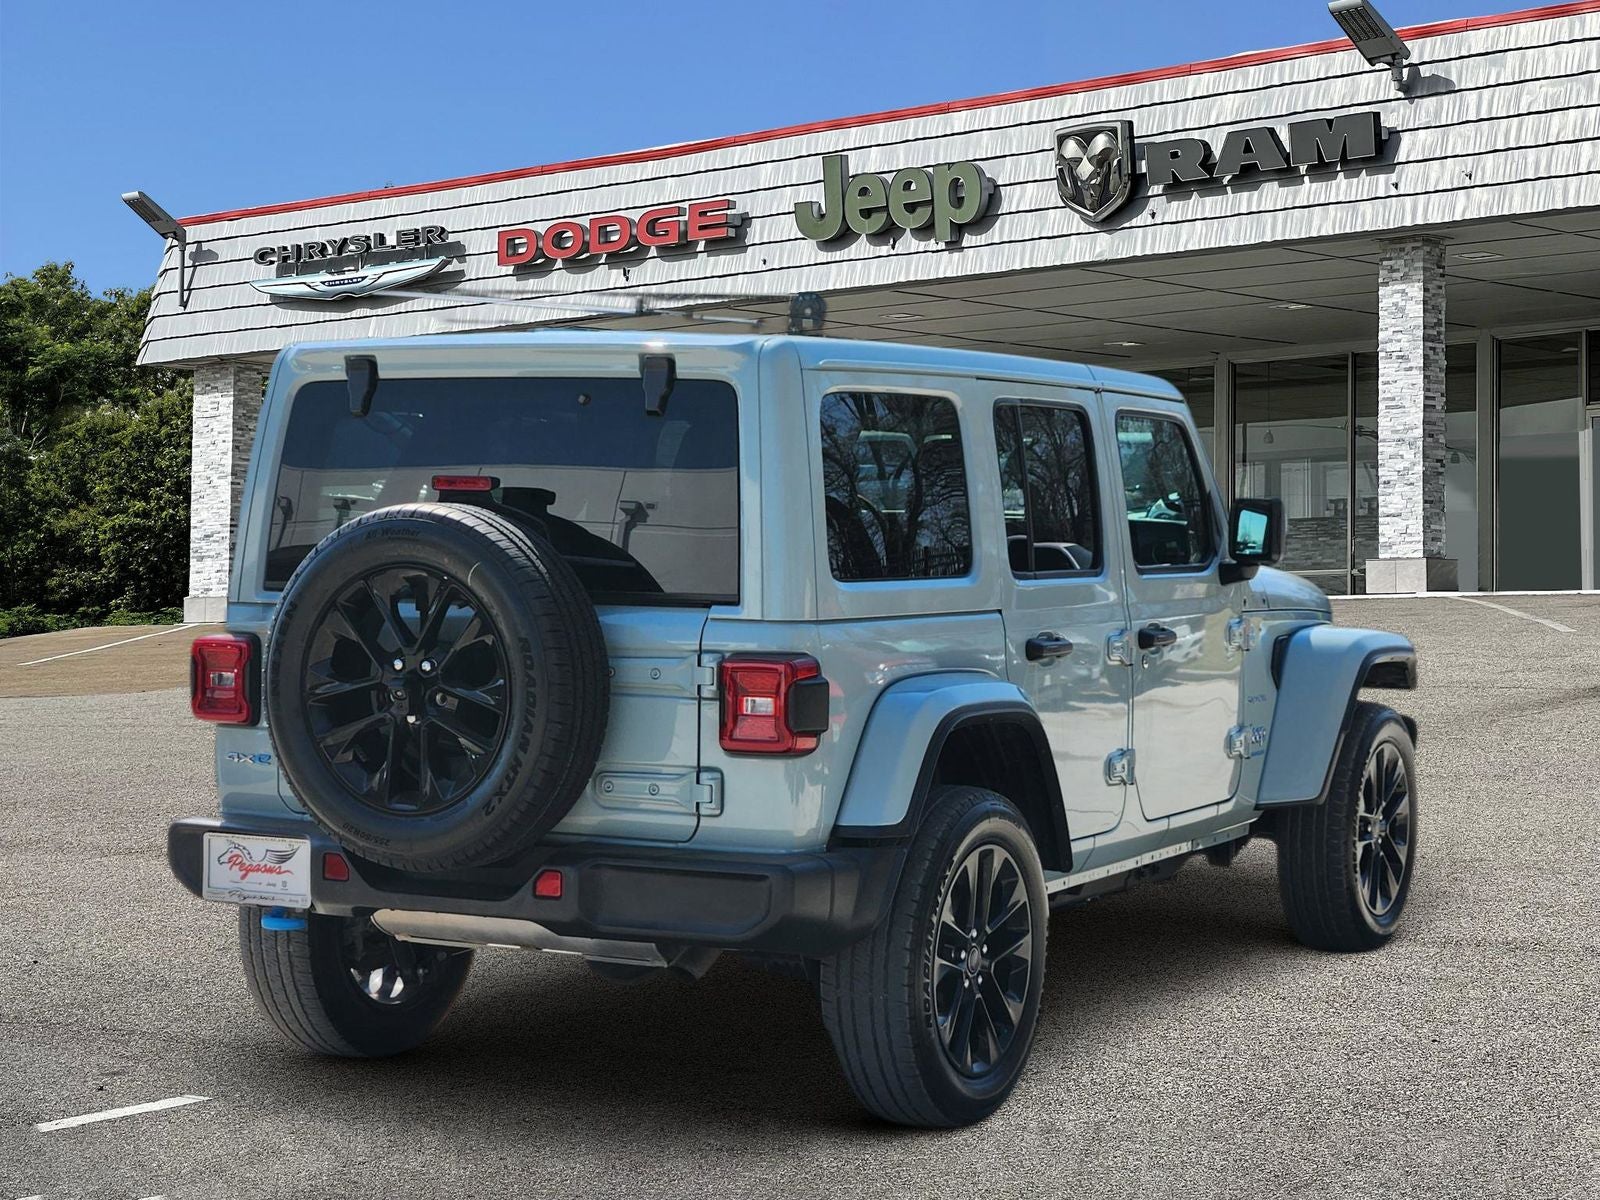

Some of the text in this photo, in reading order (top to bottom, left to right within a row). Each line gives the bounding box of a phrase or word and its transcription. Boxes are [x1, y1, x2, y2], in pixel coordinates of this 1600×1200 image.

[1145, 111, 1383, 188] RAM
[497, 198, 738, 268] DODGE
[794, 154, 990, 243] Jeep
[254, 224, 448, 268] CHRYSLER
[324, 277, 364, 287] CHRYSLER
[517, 636, 537, 755] ROADIAN
[228, 853, 296, 881] Pegasus
